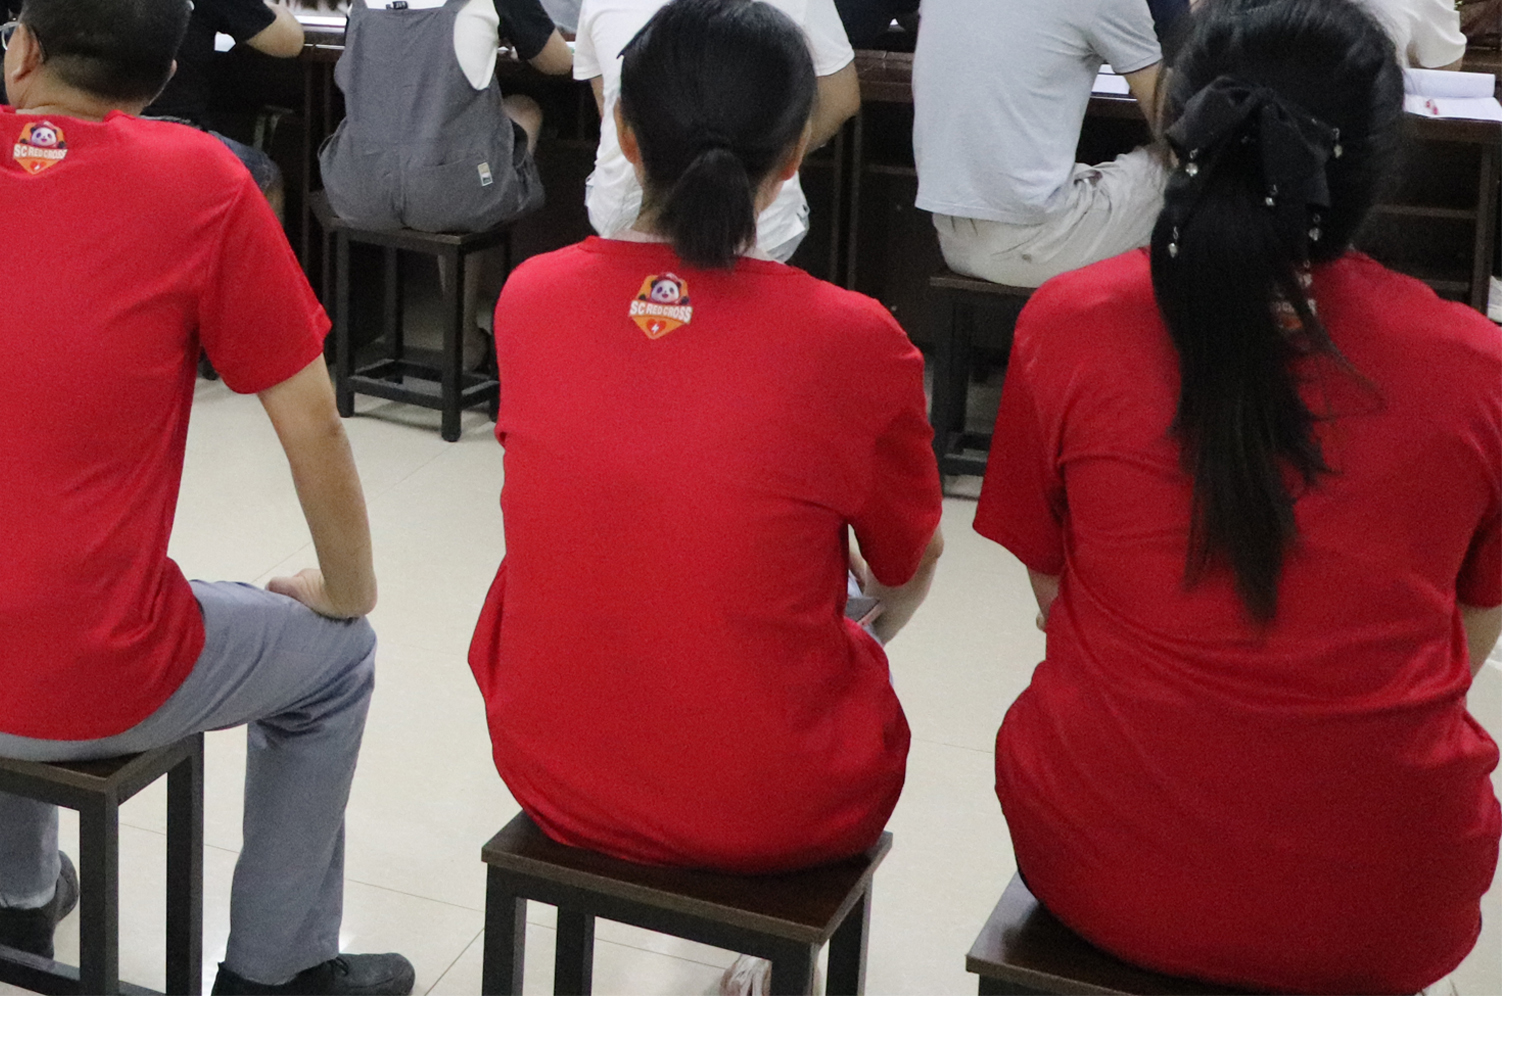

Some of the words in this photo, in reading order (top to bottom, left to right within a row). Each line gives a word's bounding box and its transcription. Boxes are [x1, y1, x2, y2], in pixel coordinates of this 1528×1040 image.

[14, 144, 28, 157] SC
[630, 300, 646, 315] SC
[663, 305, 693, 324] CROSS
